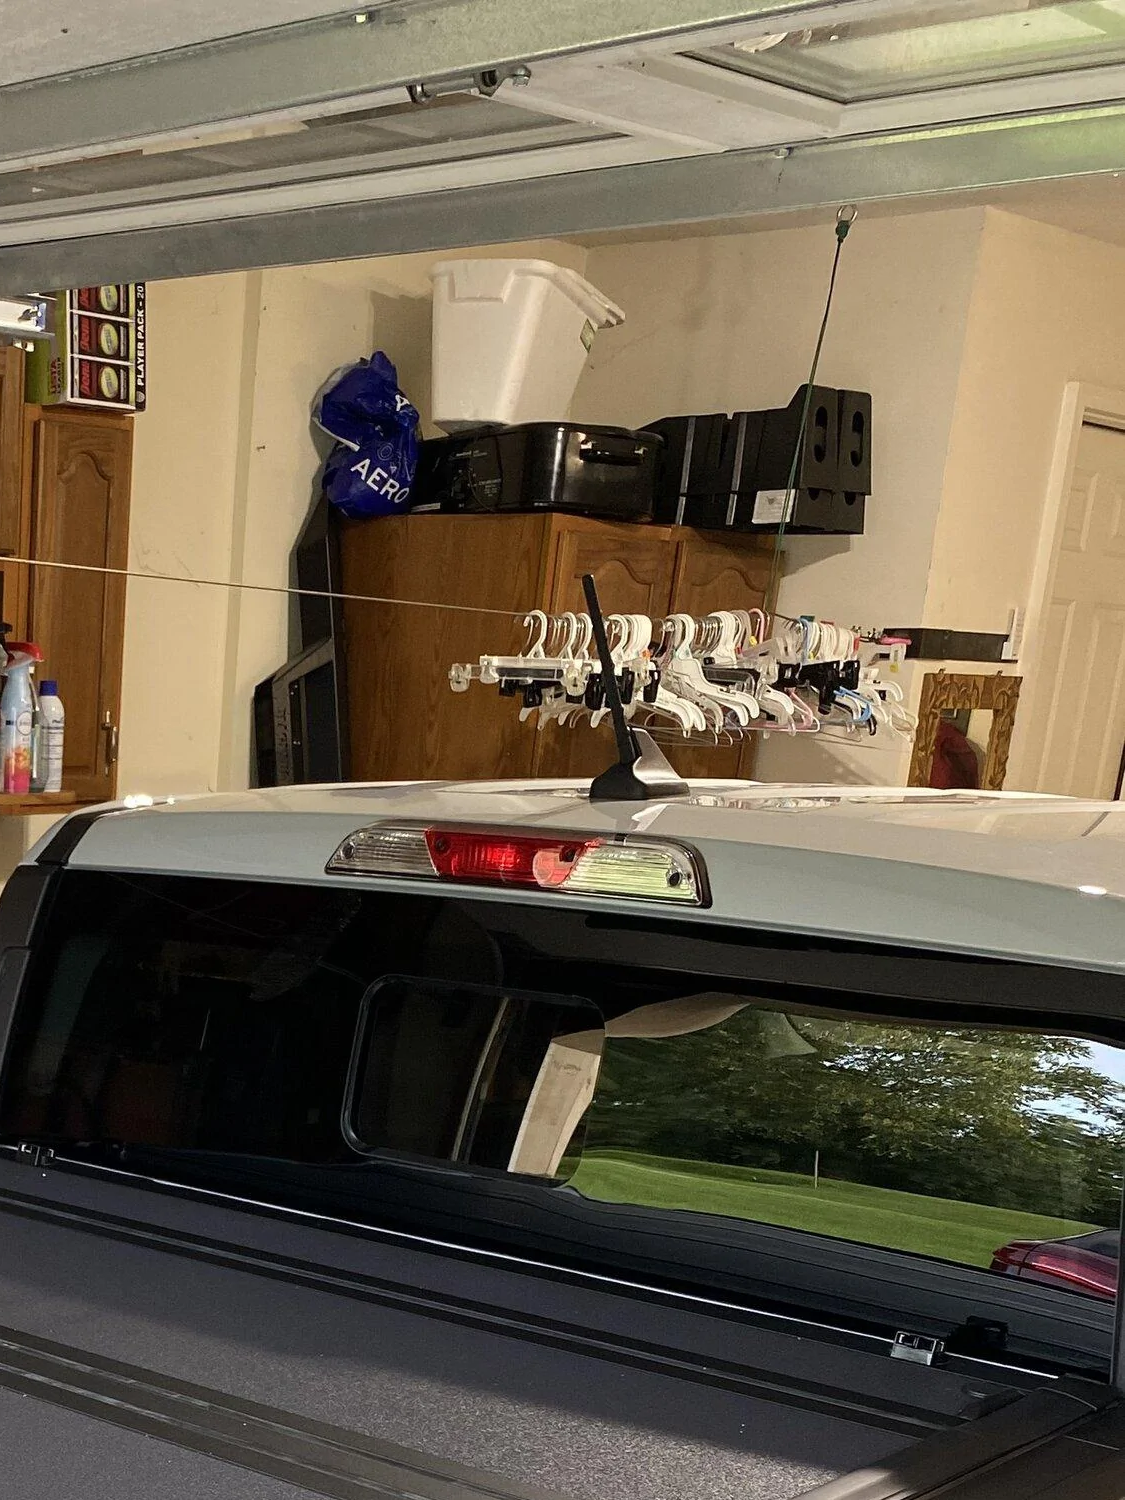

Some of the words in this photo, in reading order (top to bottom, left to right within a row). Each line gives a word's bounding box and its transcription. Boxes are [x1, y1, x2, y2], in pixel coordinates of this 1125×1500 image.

[137, 285, 145, 299] 20
[137, 308, 145, 340] PACK
[137, 341, 145, 386] PLAYER
[350, 458, 410, 504] AERO
